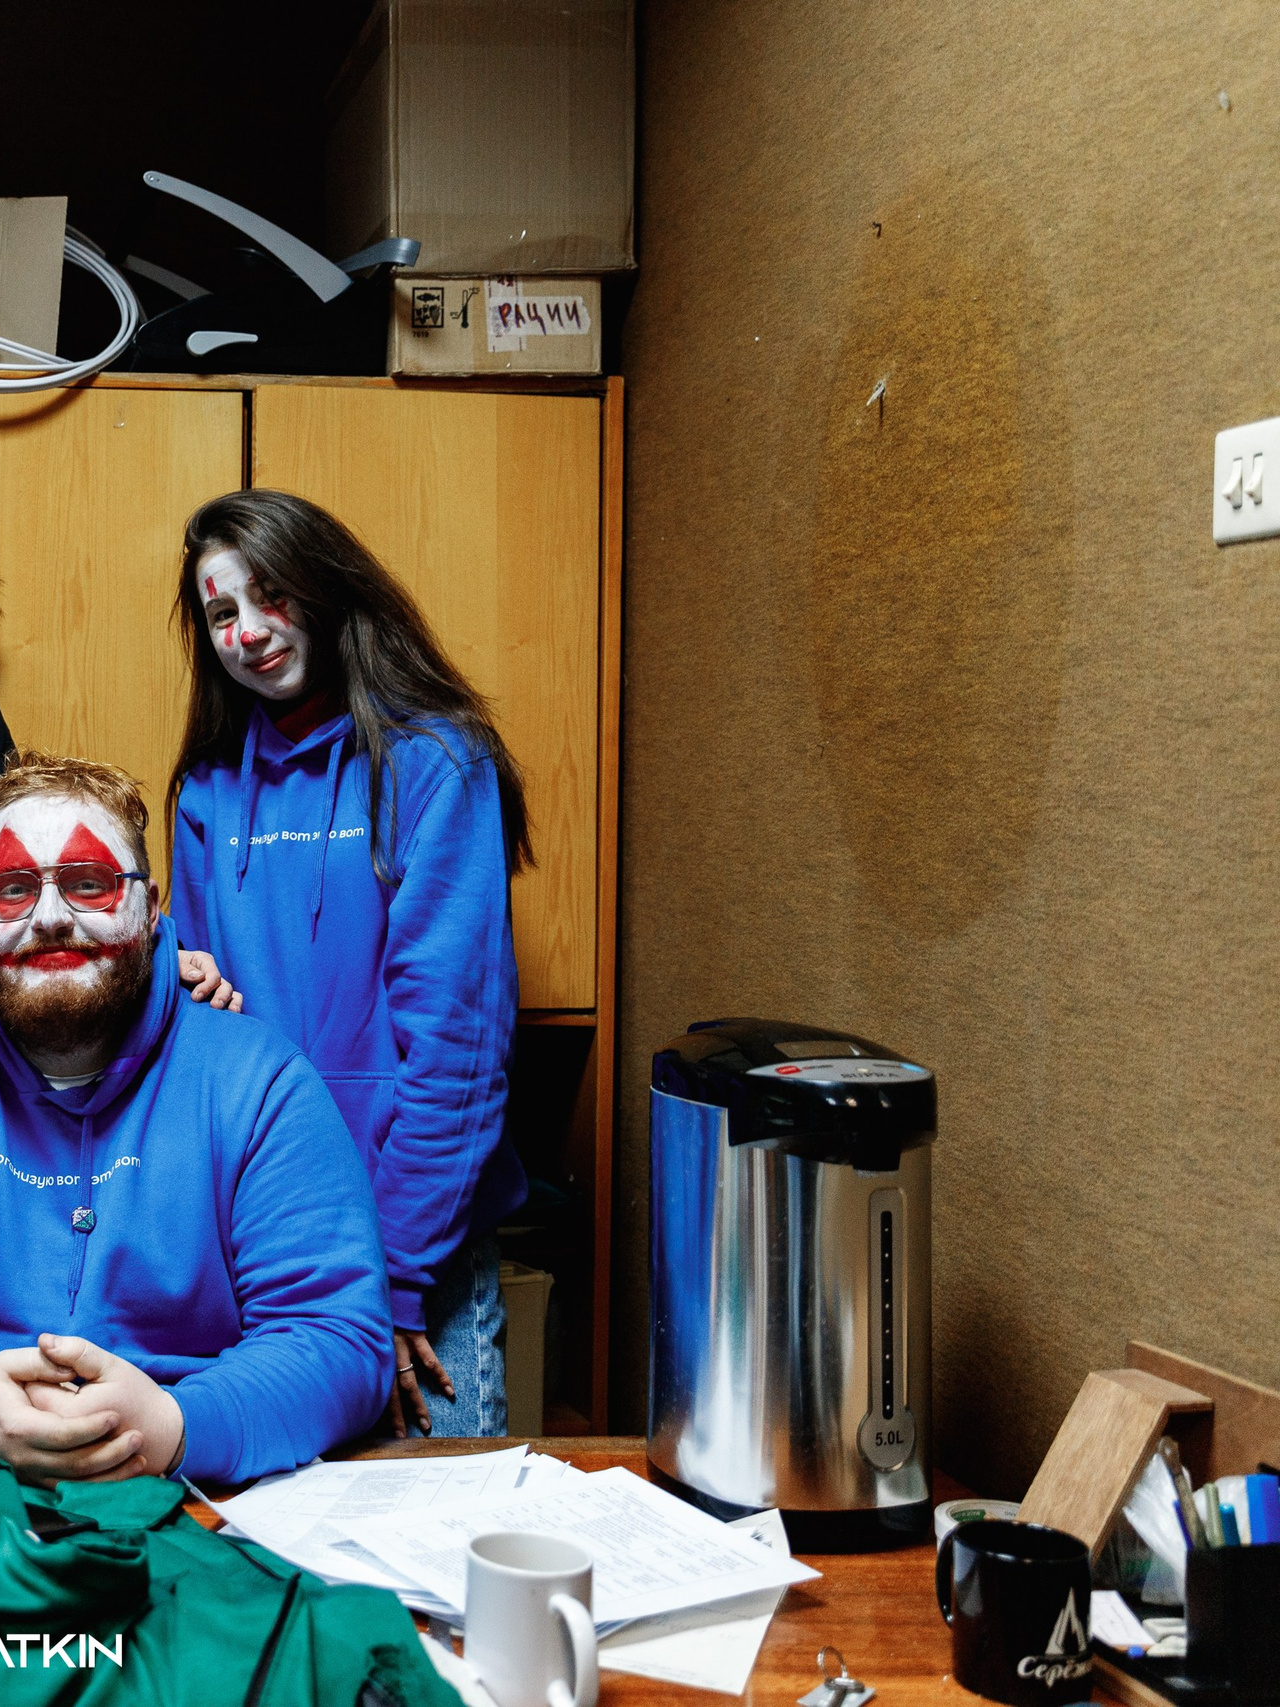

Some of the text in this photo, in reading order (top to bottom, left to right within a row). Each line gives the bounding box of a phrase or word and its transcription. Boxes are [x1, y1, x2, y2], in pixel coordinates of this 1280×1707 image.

[499, 300, 581, 335] РАЦИИ
[281, 830, 311, 842] вот
[311, 830, 337, 842] эо
[339, 827, 365, 839] вот
[114, 1155, 141, 1169] вот
[875, 1430, 905, 1447] 5.0L
